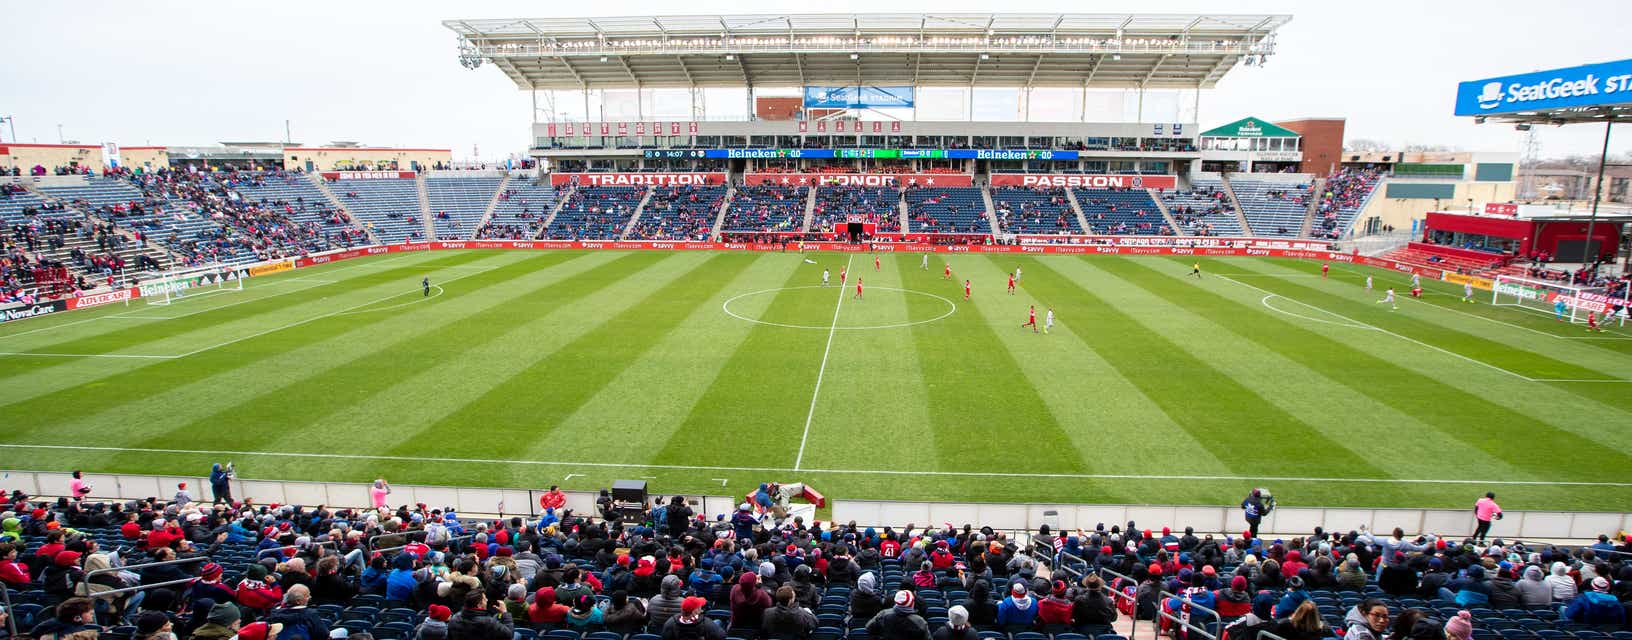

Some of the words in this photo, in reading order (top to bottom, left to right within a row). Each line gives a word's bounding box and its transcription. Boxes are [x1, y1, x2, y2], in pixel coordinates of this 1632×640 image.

[1506, 74, 1600, 103] SeatGeek
[728, 150, 777, 158] Heineken
[977, 150, 1027, 159] Heineken
[588, 174, 707, 185] TRADITION
[819, 175, 895, 186] HONOR
[1023, 176, 1123, 186] PASSION
[140, 279, 189, 297] Heineken
[6, 304, 54, 320] NovaCare
[885, 547, 894, 557] 41
